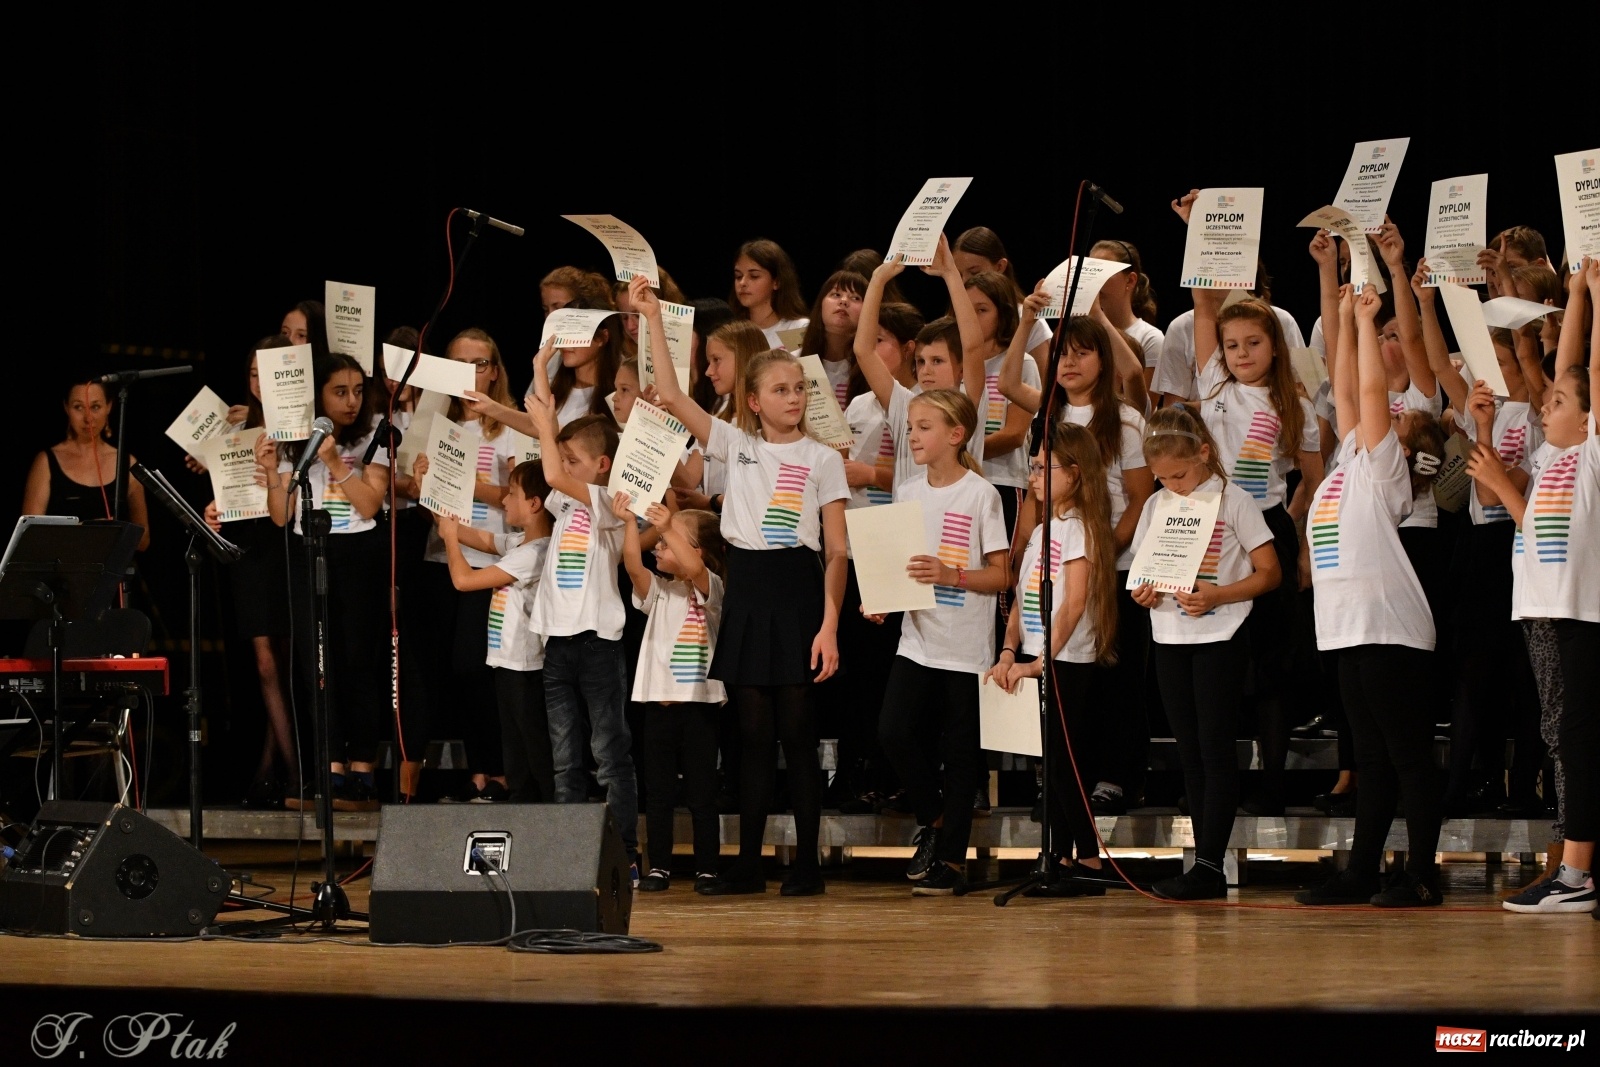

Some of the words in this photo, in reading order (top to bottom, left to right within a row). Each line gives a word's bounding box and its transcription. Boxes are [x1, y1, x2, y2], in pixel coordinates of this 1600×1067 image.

[1359, 162, 1390, 174] DYPLOM
[922, 196, 950, 204] DYPLOM
[1438, 202, 1471, 215] DYPLOM
[1205, 213, 1244, 222] DYPLOM
[335, 304, 362, 316] DYPLOM
[274, 368, 305, 380] DYPLOM
[192, 411, 218, 441] DYPLOM
[220, 448, 254, 461] DYPLOM
[438, 440, 466, 460] DYPLOM
[1432, 454, 1462, 485] DYPLOM
[621, 469, 653, 493] DYPLOM
[1166, 517, 1201, 527] DYPLOM
